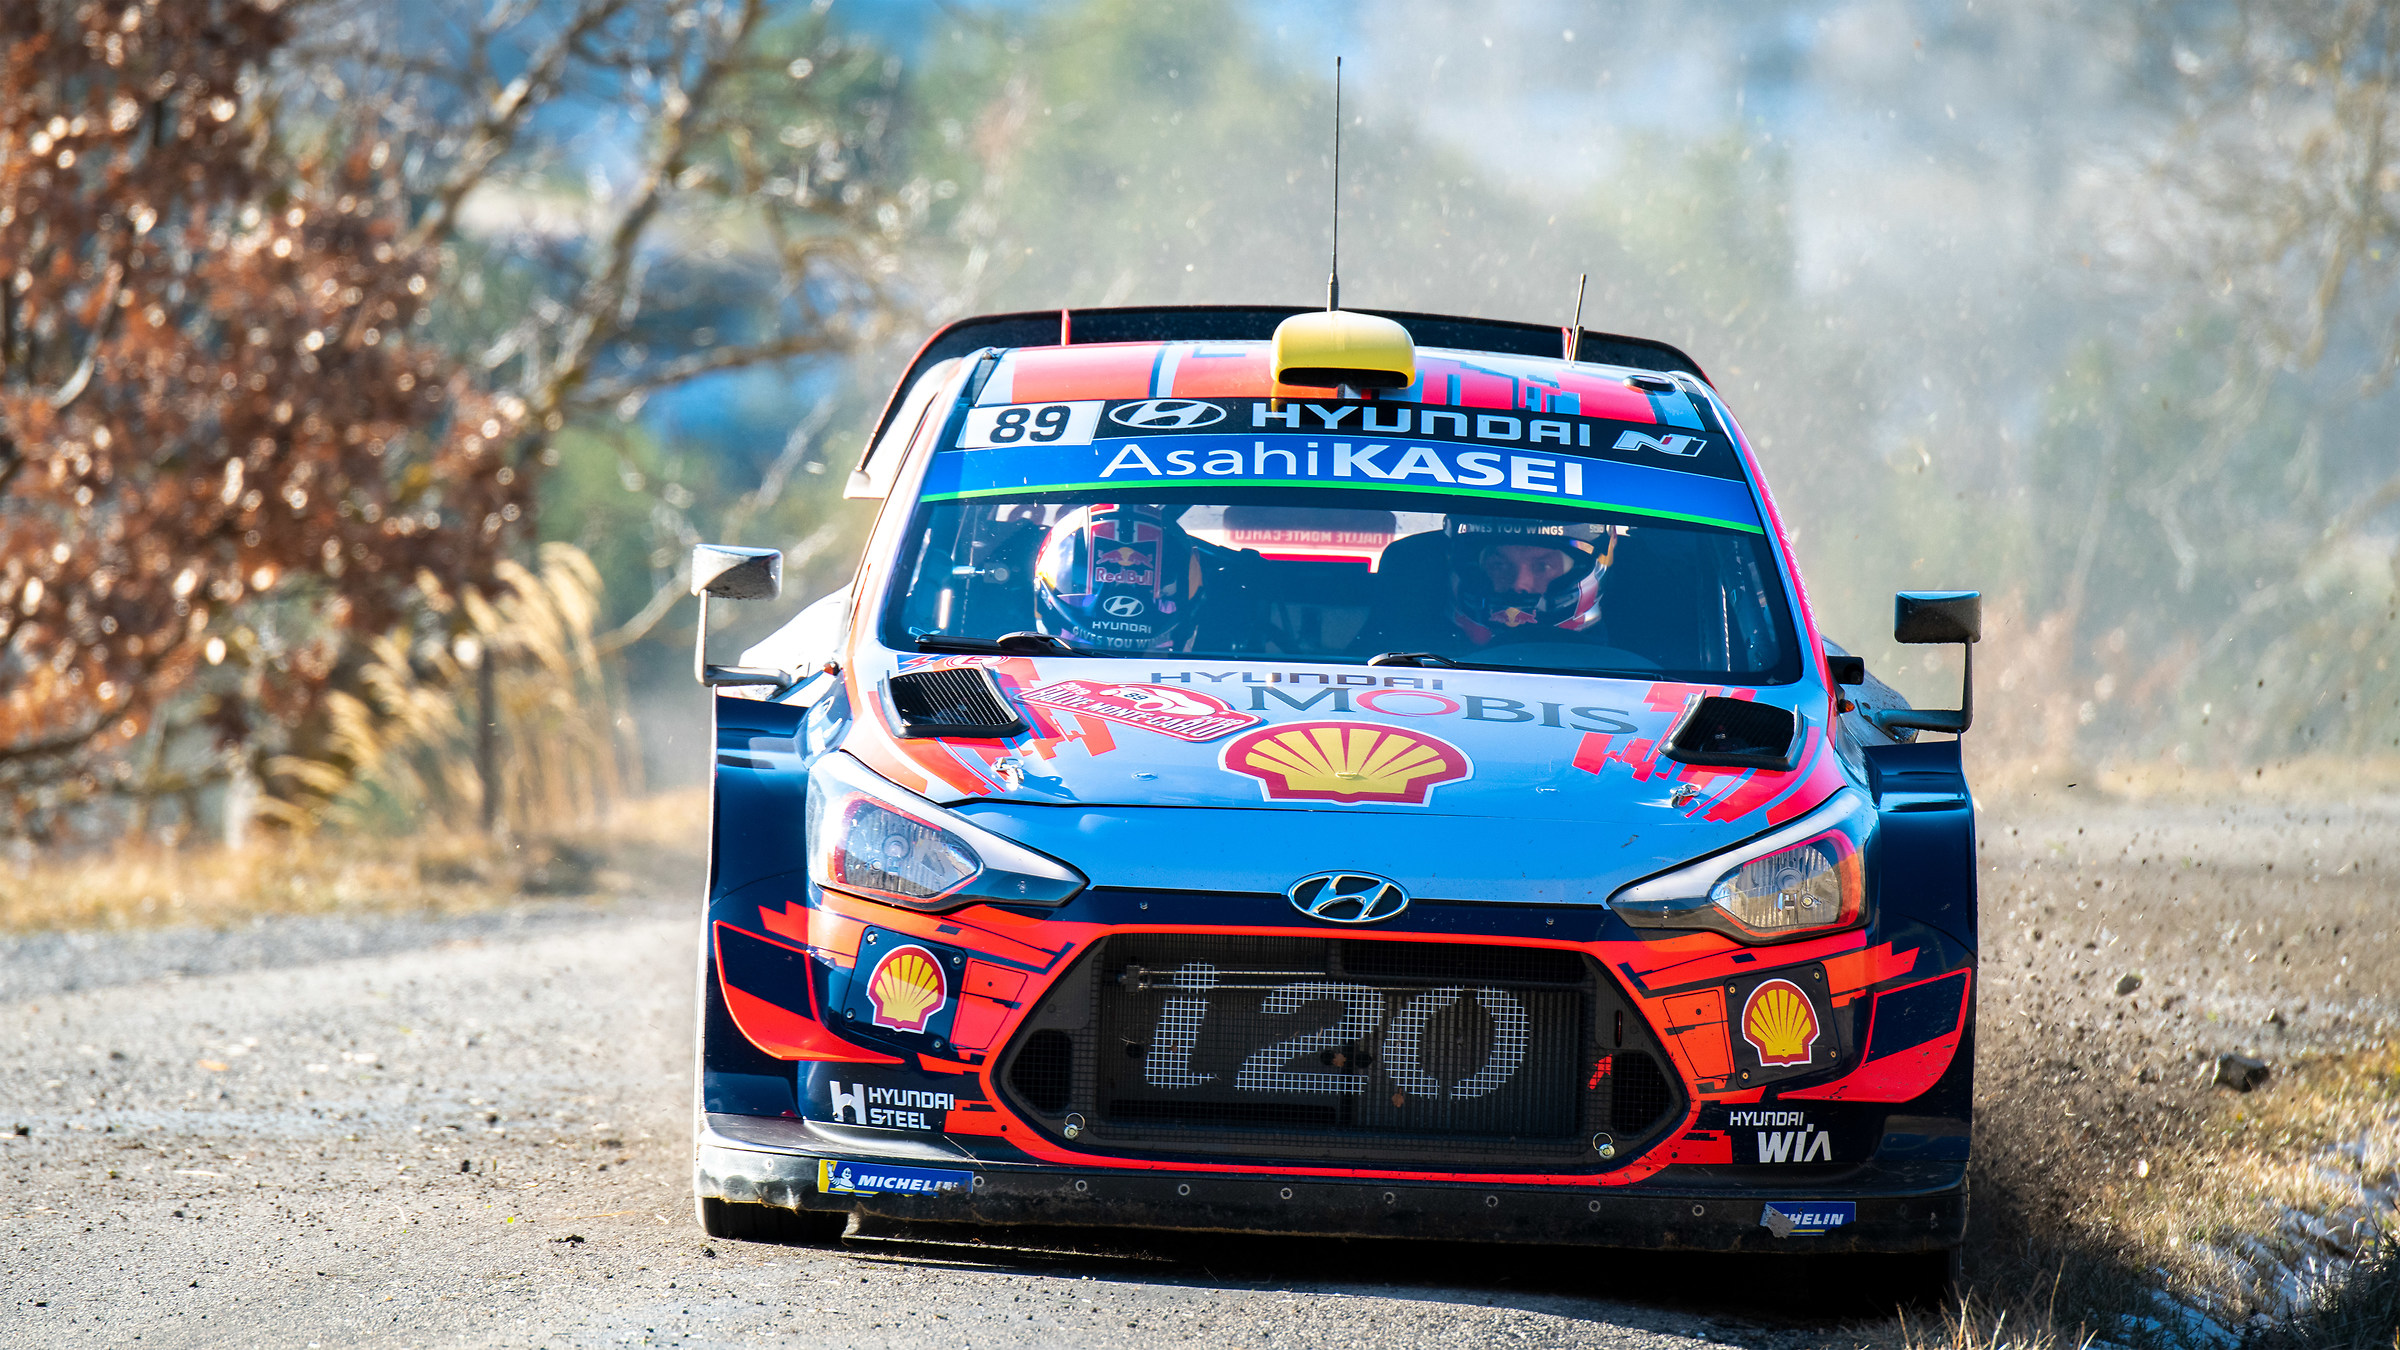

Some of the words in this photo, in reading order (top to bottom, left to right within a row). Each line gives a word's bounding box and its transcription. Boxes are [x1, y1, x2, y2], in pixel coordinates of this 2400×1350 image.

[989, 405, 1071, 444] 89
[1251, 402, 1591, 447] HYUNDAI
[1527, 525, 1564, 536] WINGS
[1095, 567, 1125, 583] Red
[1127, 569, 1153, 586] Bull
[1092, 621, 1151, 634] HYUNDAI
[1106, 636, 1132, 648] YOU
[1151, 671, 1443, 690] HYUNDAI
[1245, 685, 1639, 735] MOBIS
[868, 1087, 955, 1110] HYUNDAI
[870, 1109, 931, 1130] STEEL
[1729, 1111, 1804, 1126] HYUNDAI
[1783, 1213, 1844, 1225] HELIN
